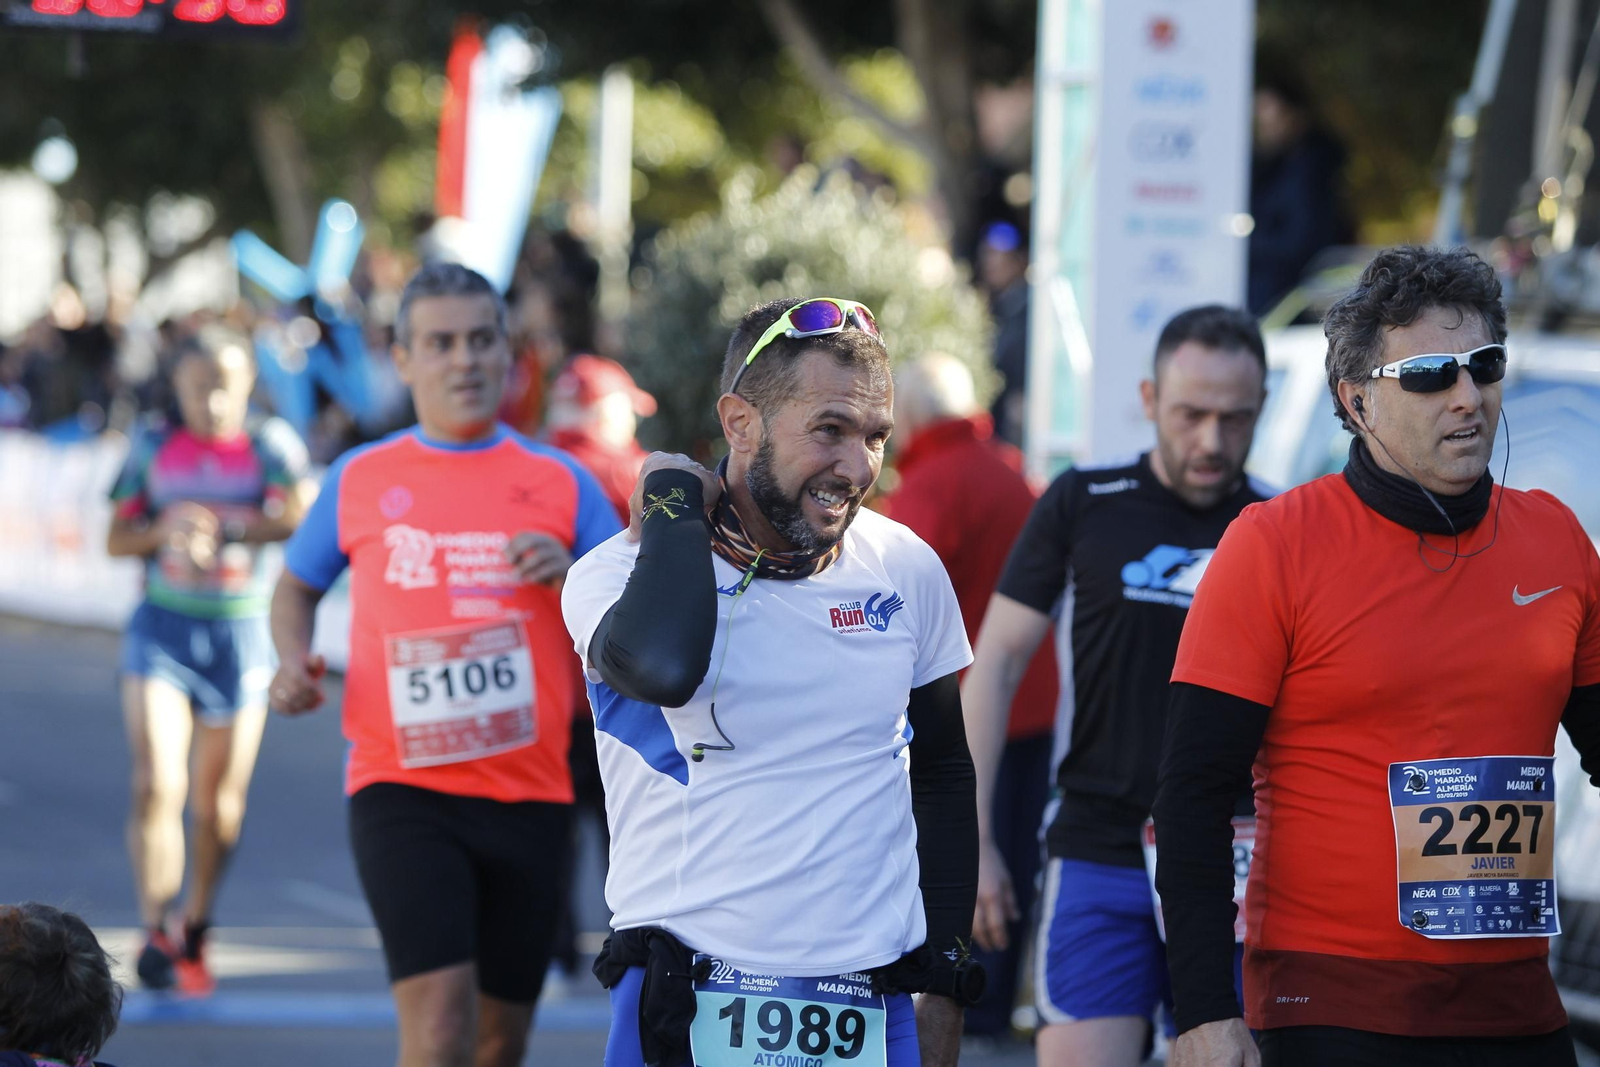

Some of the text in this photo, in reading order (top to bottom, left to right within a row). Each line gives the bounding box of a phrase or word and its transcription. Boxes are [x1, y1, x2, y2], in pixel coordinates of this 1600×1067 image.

[839, 601, 862, 611] CLUB
[829, 607, 886, 629] Run 04
[408, 656, 516, 705] 5106
[1434, 767, 1462, 776] MEDIO
[1521, 766, 1545, 777] MEDIO
[1435, 774, 1477, 785] MARATÓN
[1436, 783, 1474, 793] ALMERÍA
[1419, 803, 1543, 857] 2227
[1471, 857, 1515, 869] JAVIER
[1412, 885, 1462, 899] NEXA CDX
[740, 977, 779, 987] ALMERÍA
[740, 984, 773, 993] 03/02/2019
[817, 981, 872, 998] MARATÓN
[1276, 996, 1310, 1004] DRI-FIT
[718, 996, 866, 1060] 1989
[753, 1051, 824, 1067] ATÓMICO
